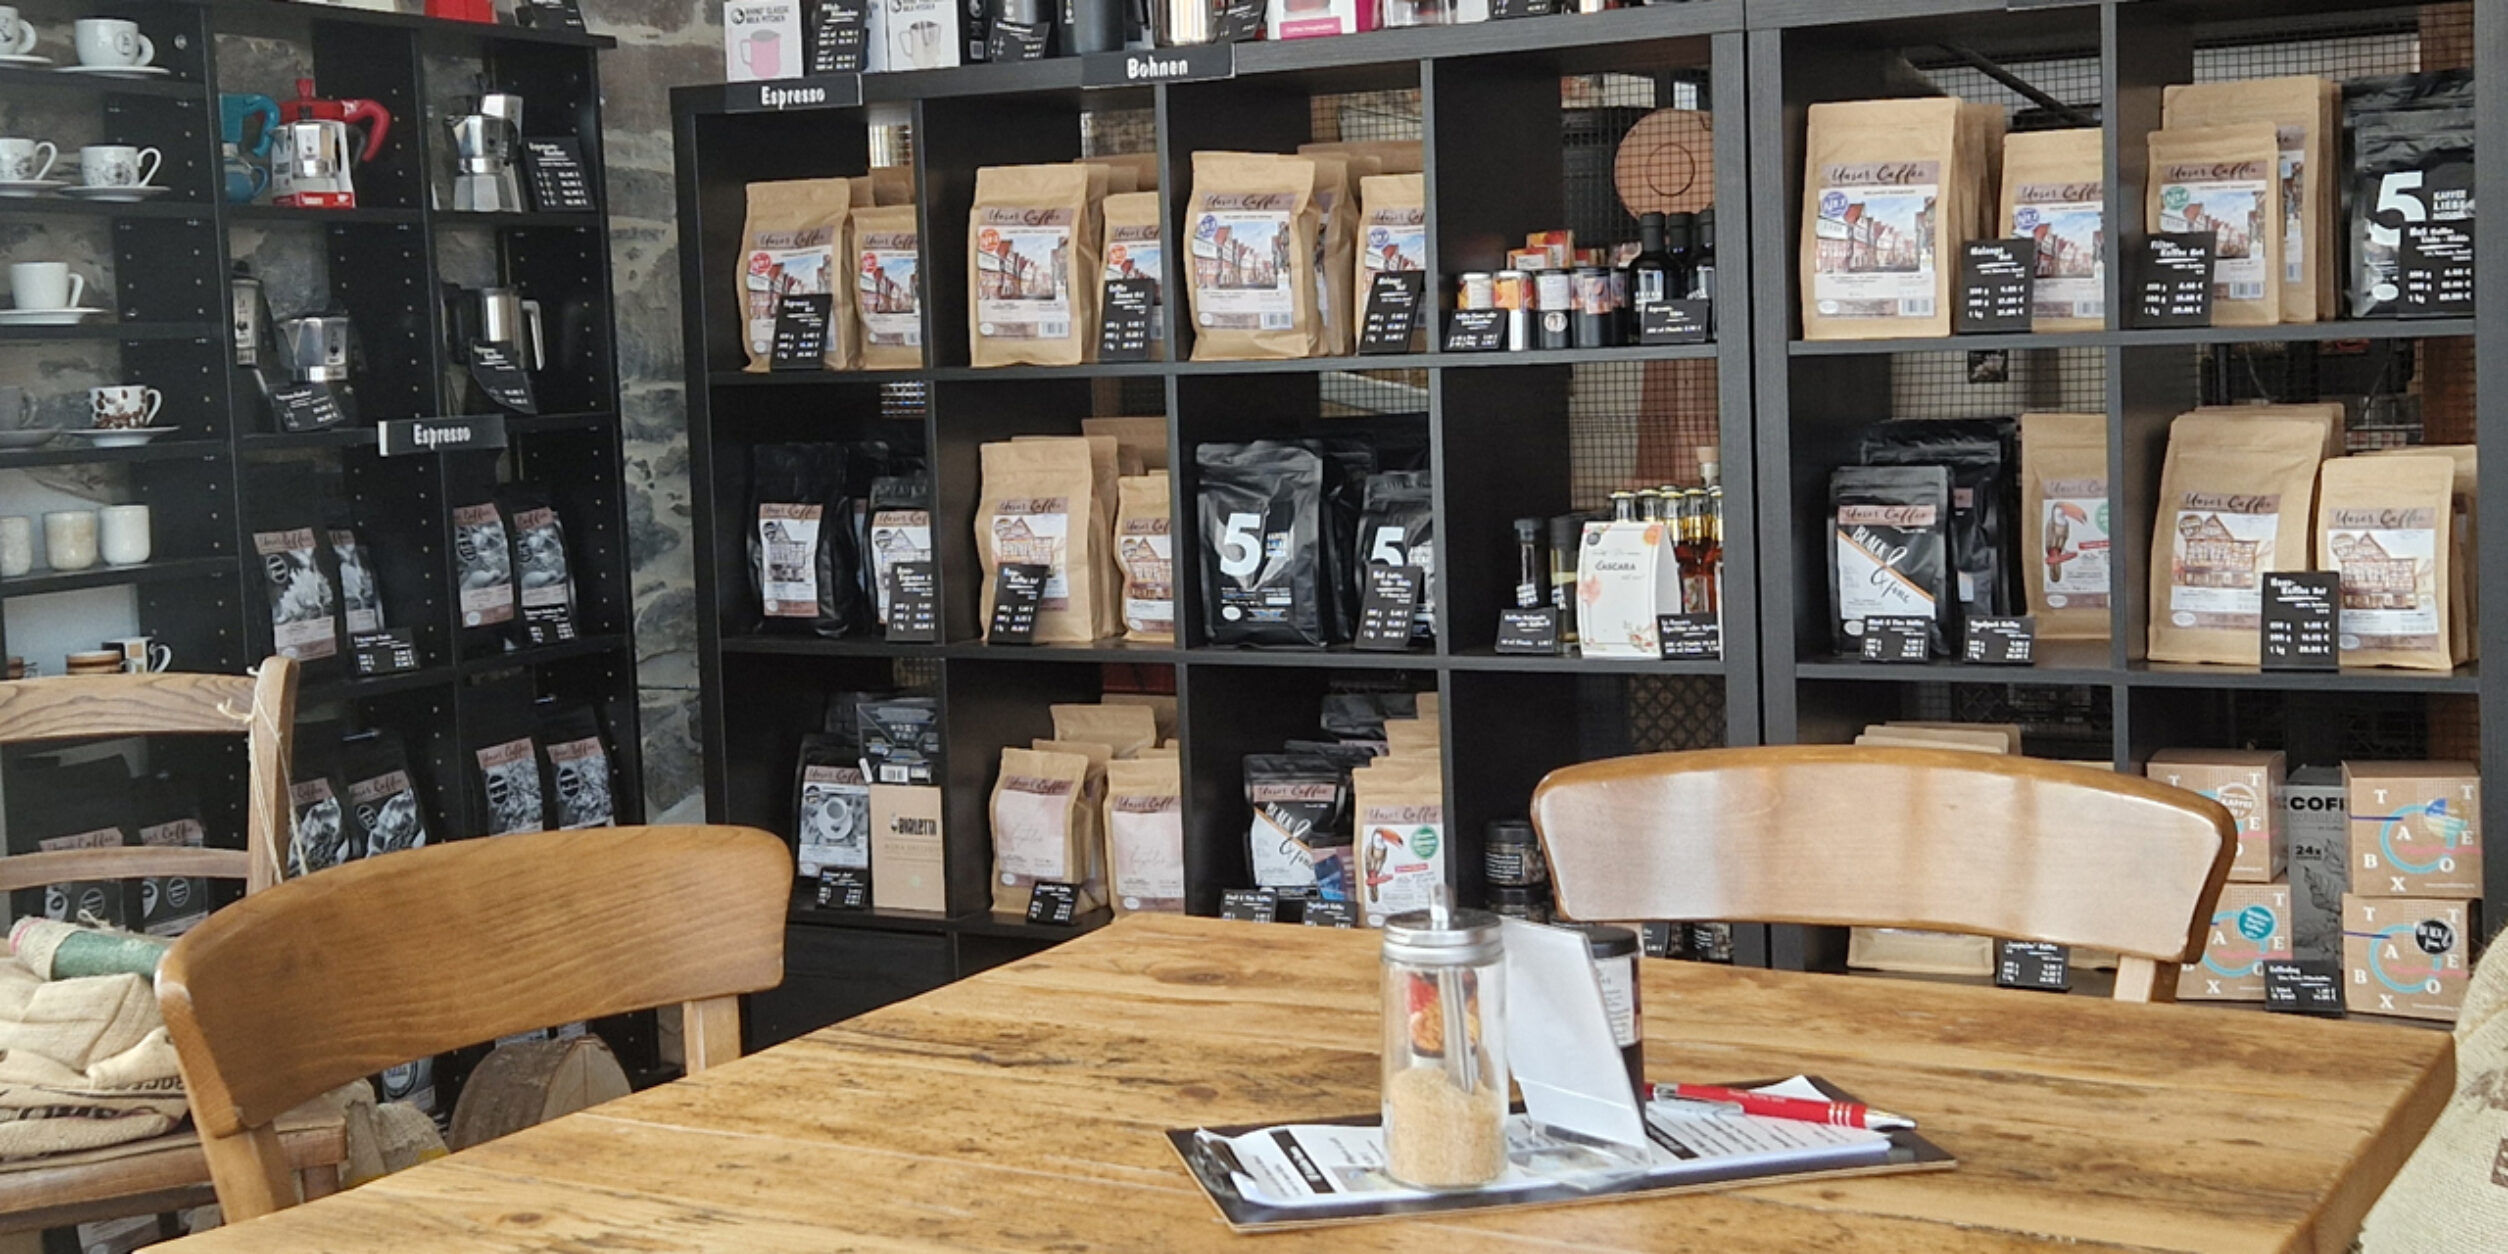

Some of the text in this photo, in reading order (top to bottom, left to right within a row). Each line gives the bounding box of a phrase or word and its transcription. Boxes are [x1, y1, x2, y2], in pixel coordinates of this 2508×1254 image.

[1126, 55, 1189, 79] Bohnen
[761, 85, 826, 110] Espresso
[2371, 170, 2427, 246] 5
[413, 424, 471, 451] Espresso
[1220, 513, 1262, 576] 5
[1852, 525, 1888, 557] BLACK
